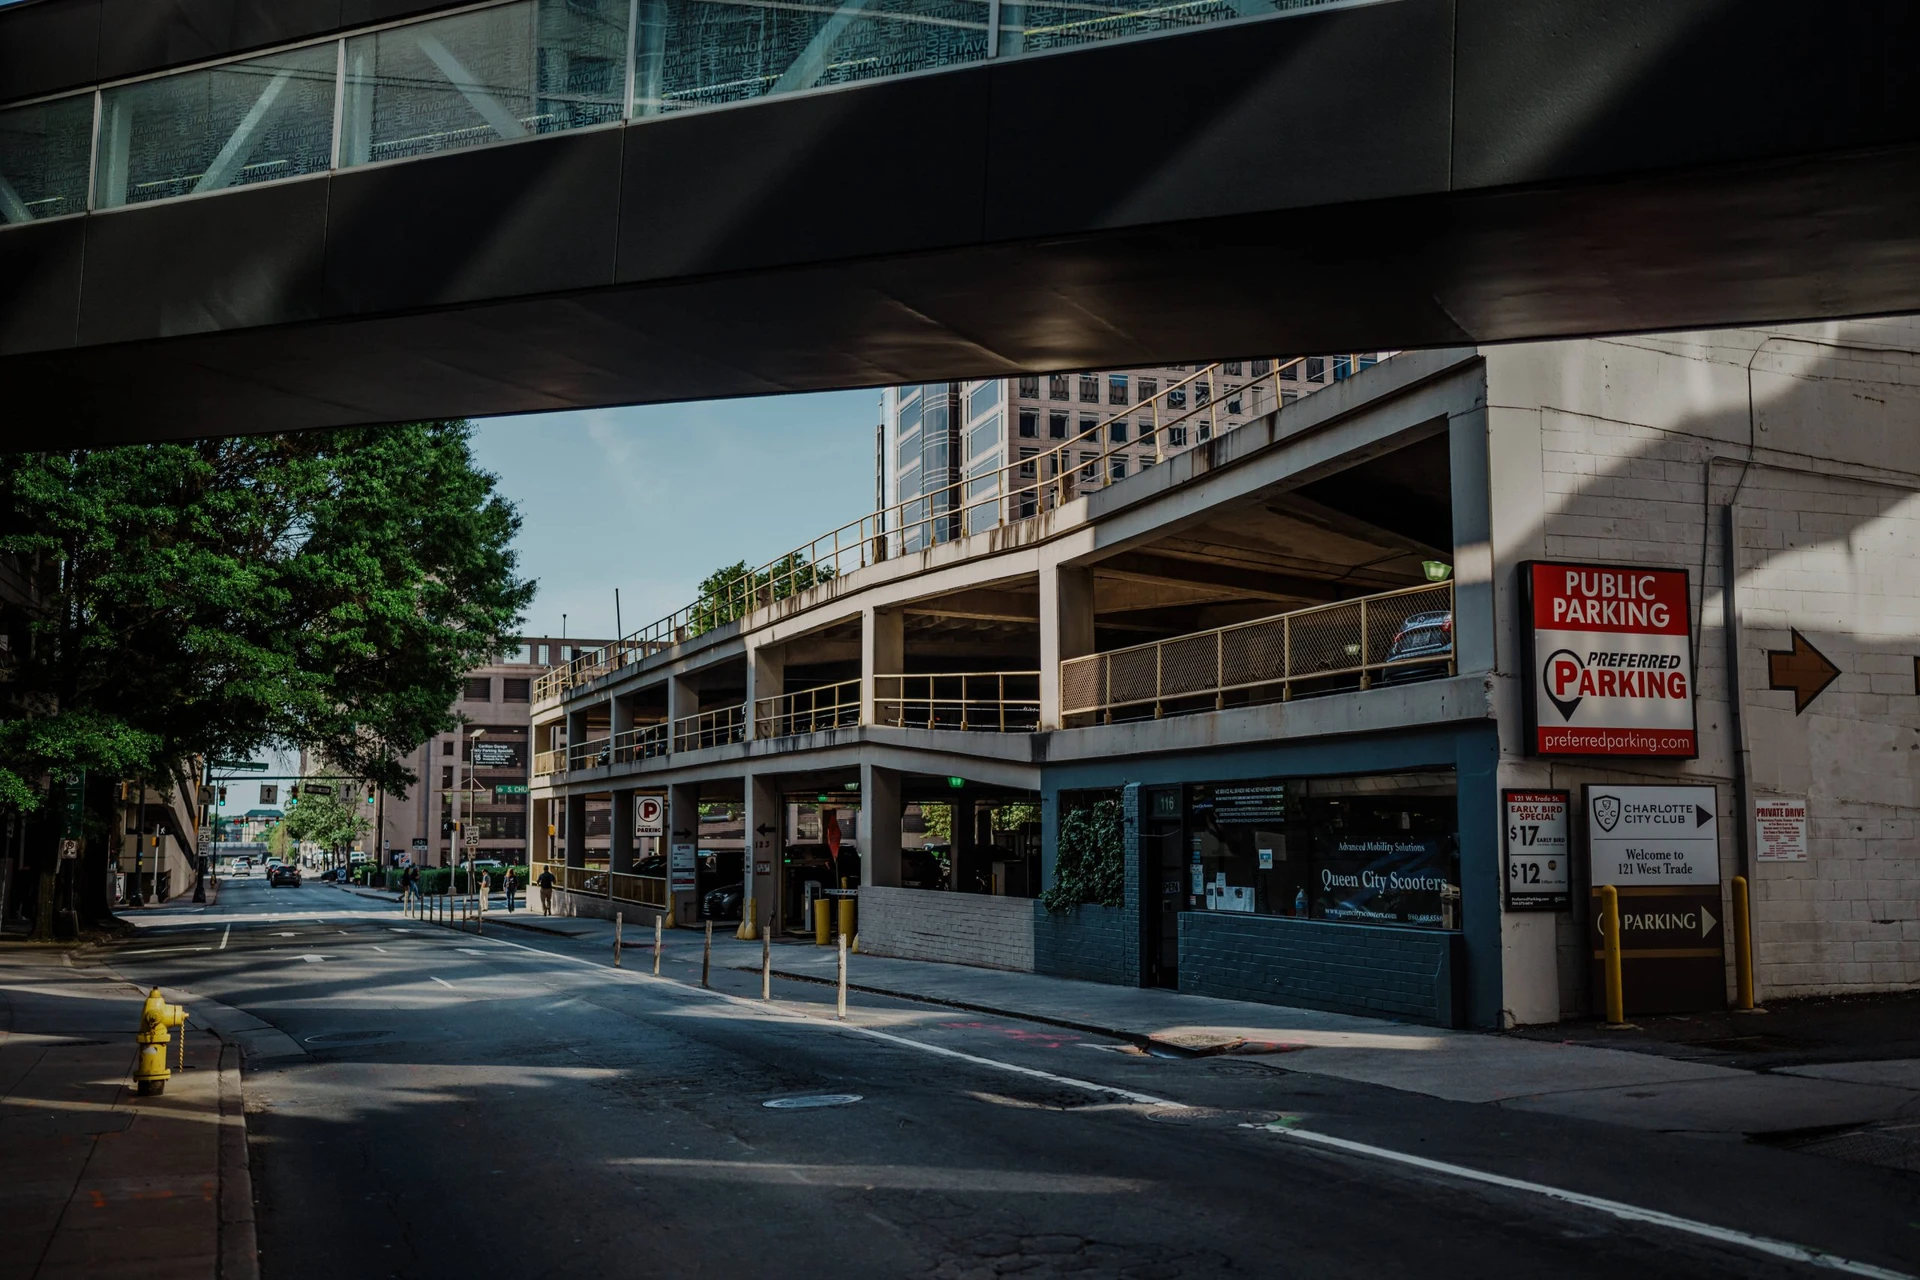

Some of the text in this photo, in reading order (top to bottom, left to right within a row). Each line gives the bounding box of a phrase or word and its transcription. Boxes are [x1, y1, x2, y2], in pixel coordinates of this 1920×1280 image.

[1565, 570, 1656, 601] PUBLIC
[1553, 597, 1671, 628] PARKING
[1587, 652, 1681, 669] PREFERRED
[1555, 661, 1687, 699] PARKING
[1545, 730, 1690, 752] preferredparking.com
[1160, 796, 1174, 810] 116
[1511, 805, 1563, 813] EARLY BIRD
[1624, 804, 1693, 813] CHARLOTTE
[644, 802, 657, 818] P
[1756, 807, 1805, 818] PRIVATE DRIVE
[1519, 813, 1556, 821] SPECIAL
[1624, 815, 1686, 824] CITY CLUB
[466, 836, 478, 844] 25
[1338, 842, 1425, 855] Advanced Mobility Solutions
[1626, 849, 1684, 860] Welcome to
[1618, 863, 1693, 875] 121 West Trade
[1163, 881, 1179, 891] PEN
[1321, 869, 1448, 894] Queen City Scooters
[1623, 912, 1697, 931] PARKING
